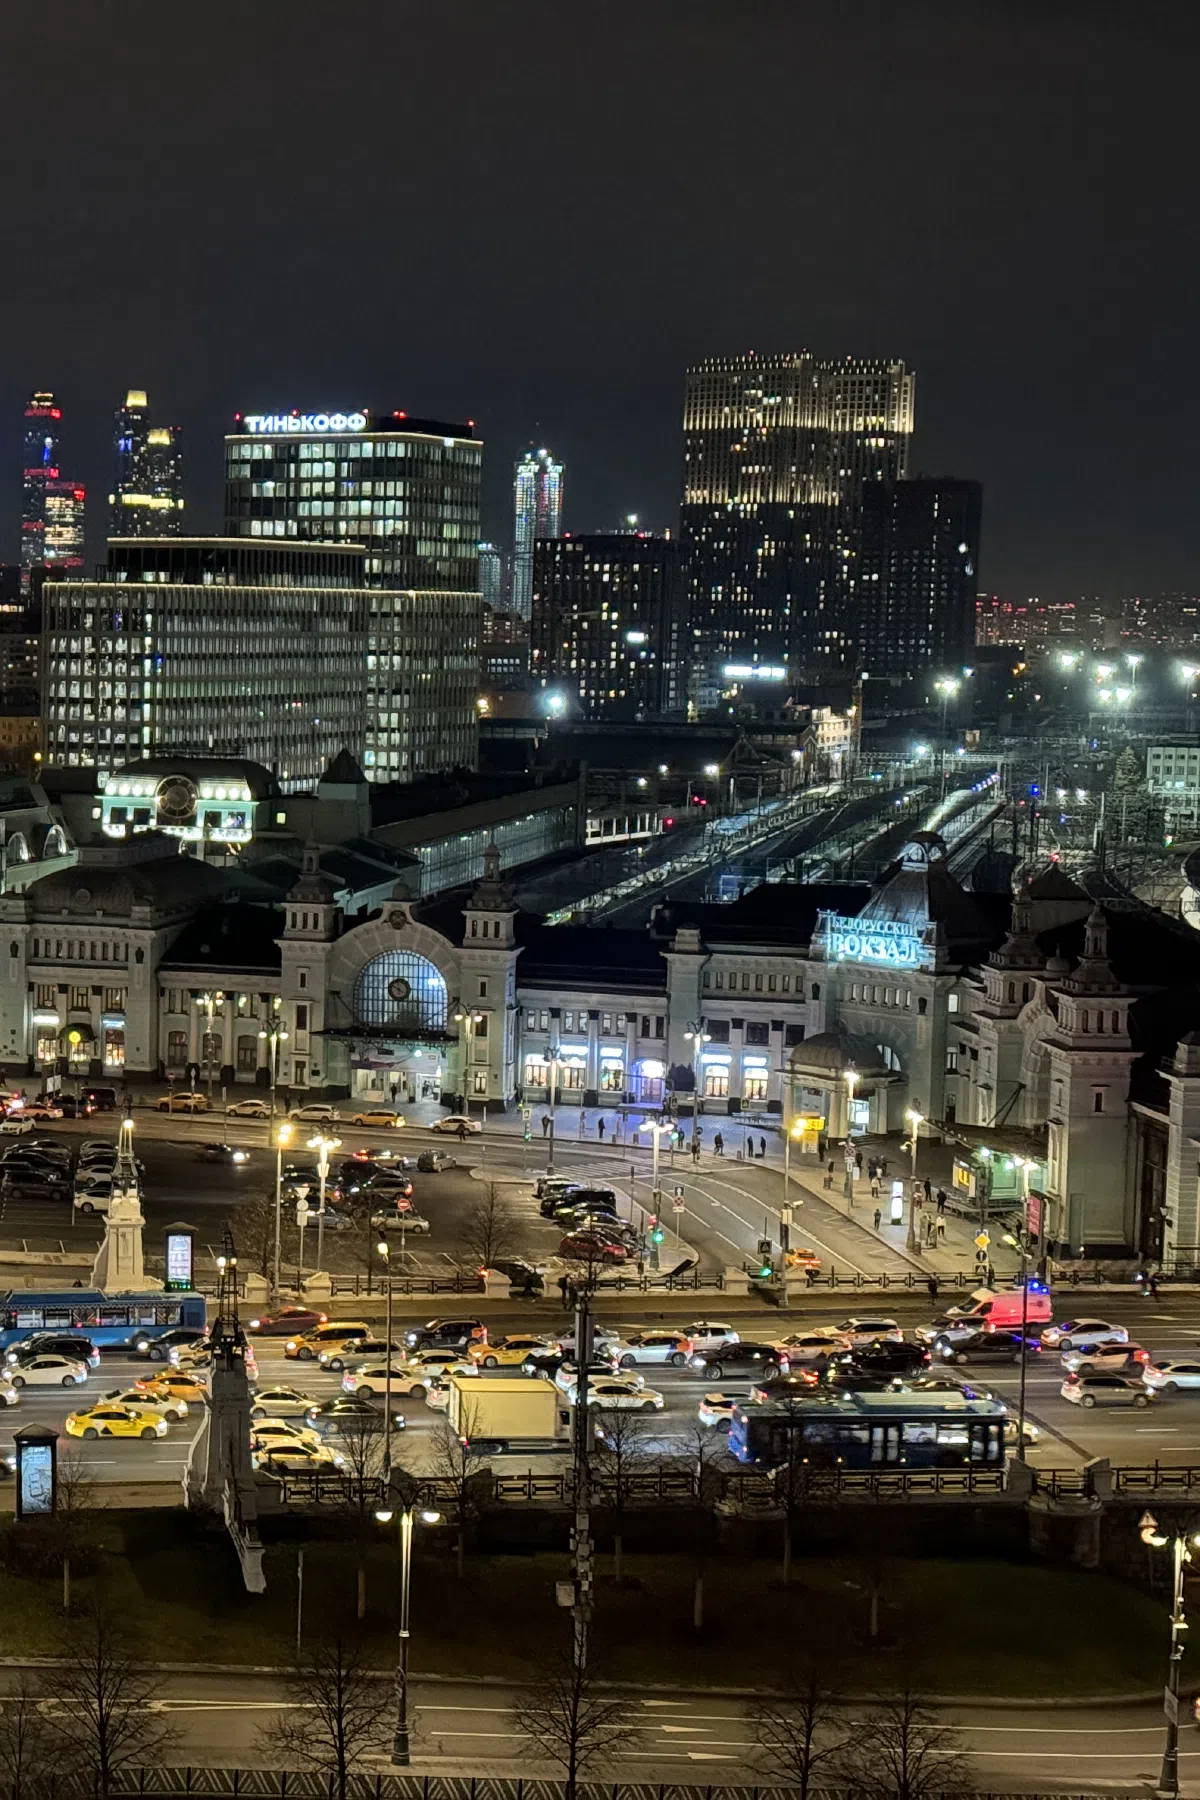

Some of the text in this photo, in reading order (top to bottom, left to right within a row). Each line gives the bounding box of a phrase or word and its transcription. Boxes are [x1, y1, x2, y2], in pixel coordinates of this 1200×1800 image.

[245, 413, 367, 433] ТИНЬКОФФ
[832, 916, 918, 937] БЕЛОРУССКИЙ
[832, 933, 918, 963] ВОКЗАЛ
